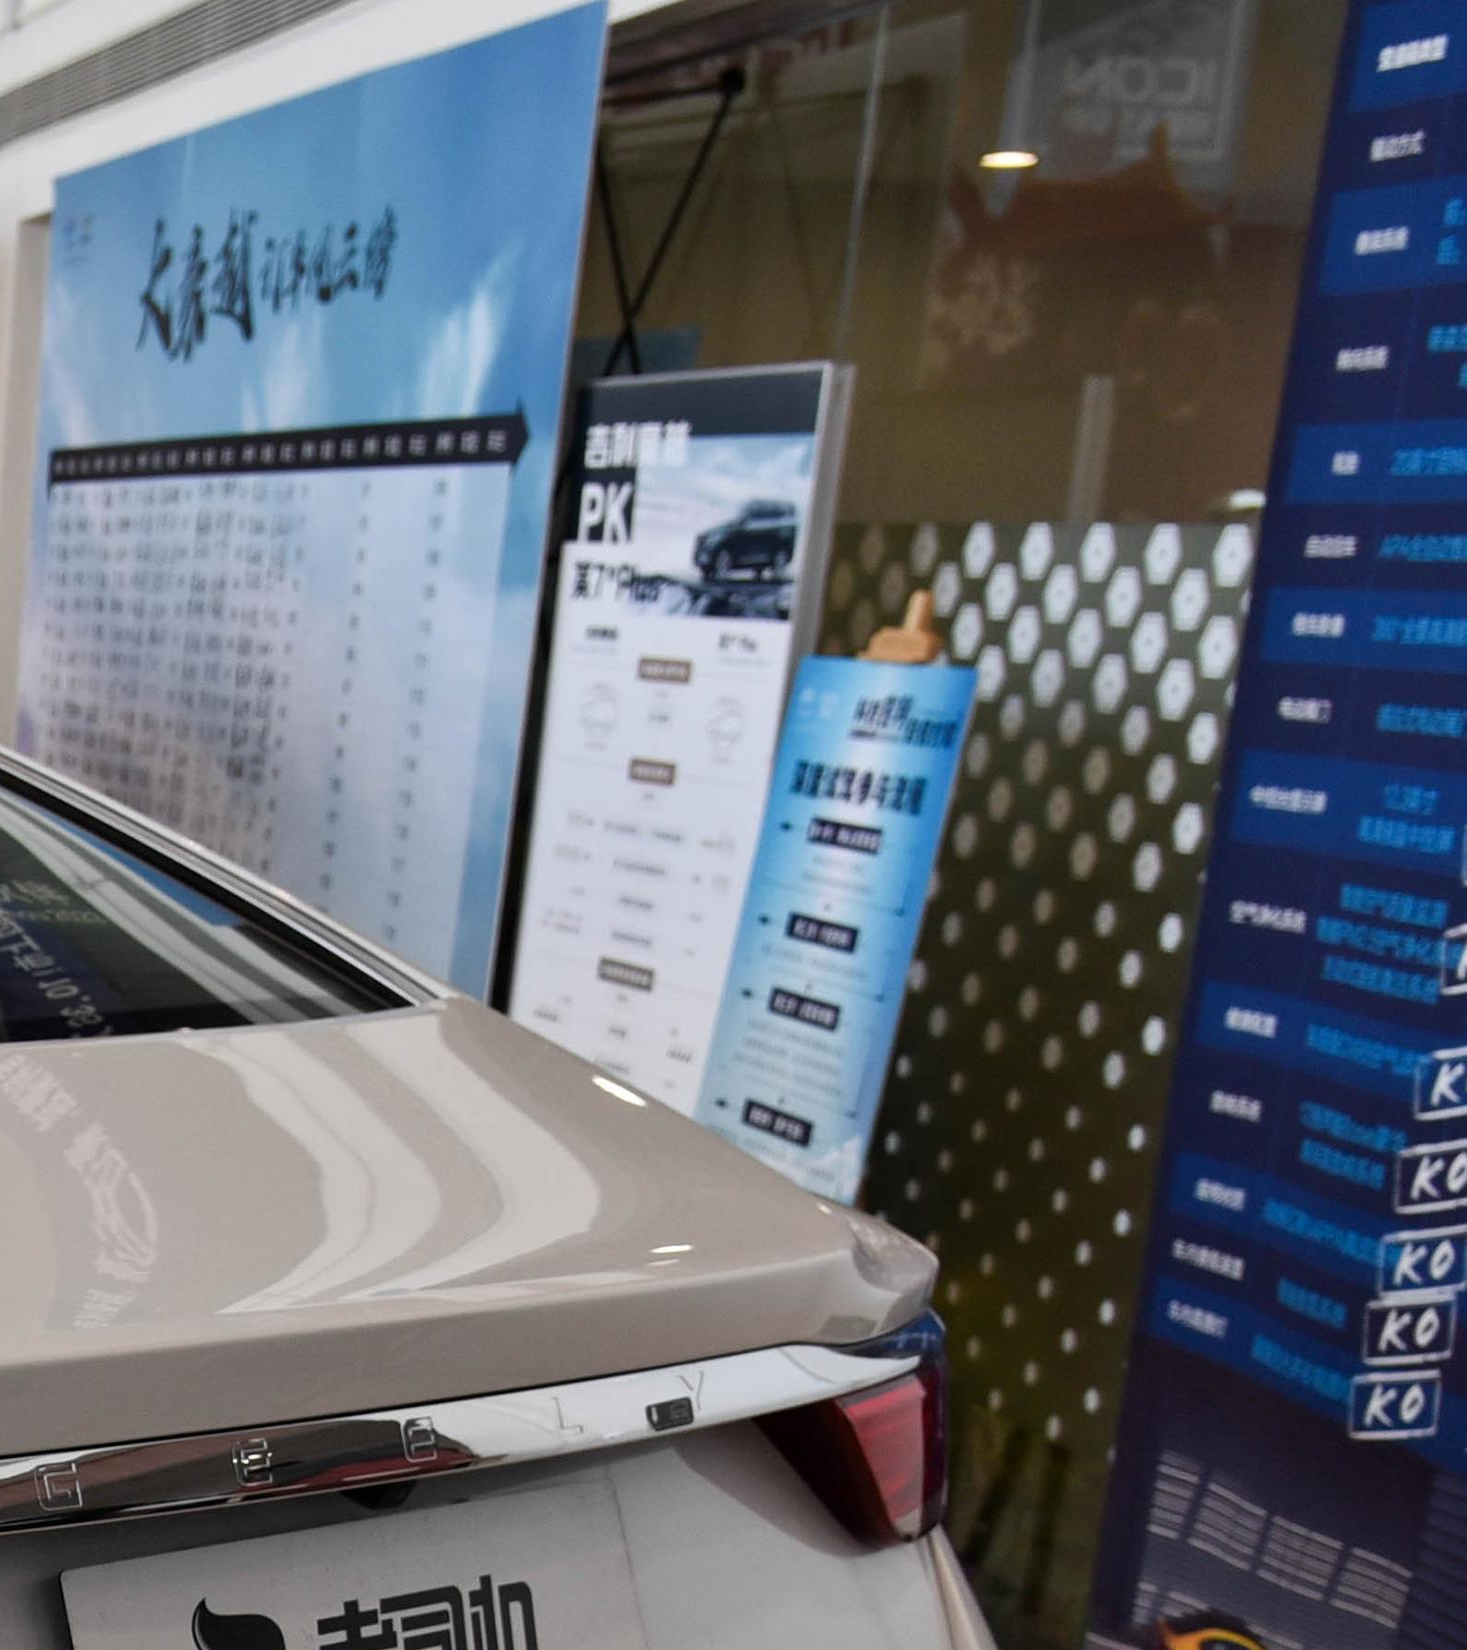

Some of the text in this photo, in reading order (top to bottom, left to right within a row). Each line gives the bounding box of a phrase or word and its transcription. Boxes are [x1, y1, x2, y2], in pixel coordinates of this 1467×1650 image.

[578, 482, 634, 544] PK
[1392, 1239, 1455, 1286] KO
[1377, 1306, 1440, 1352] KO
[1362, 1384, 1425, 1429] KO
[36, 1370, 707, 1512] GEELY
